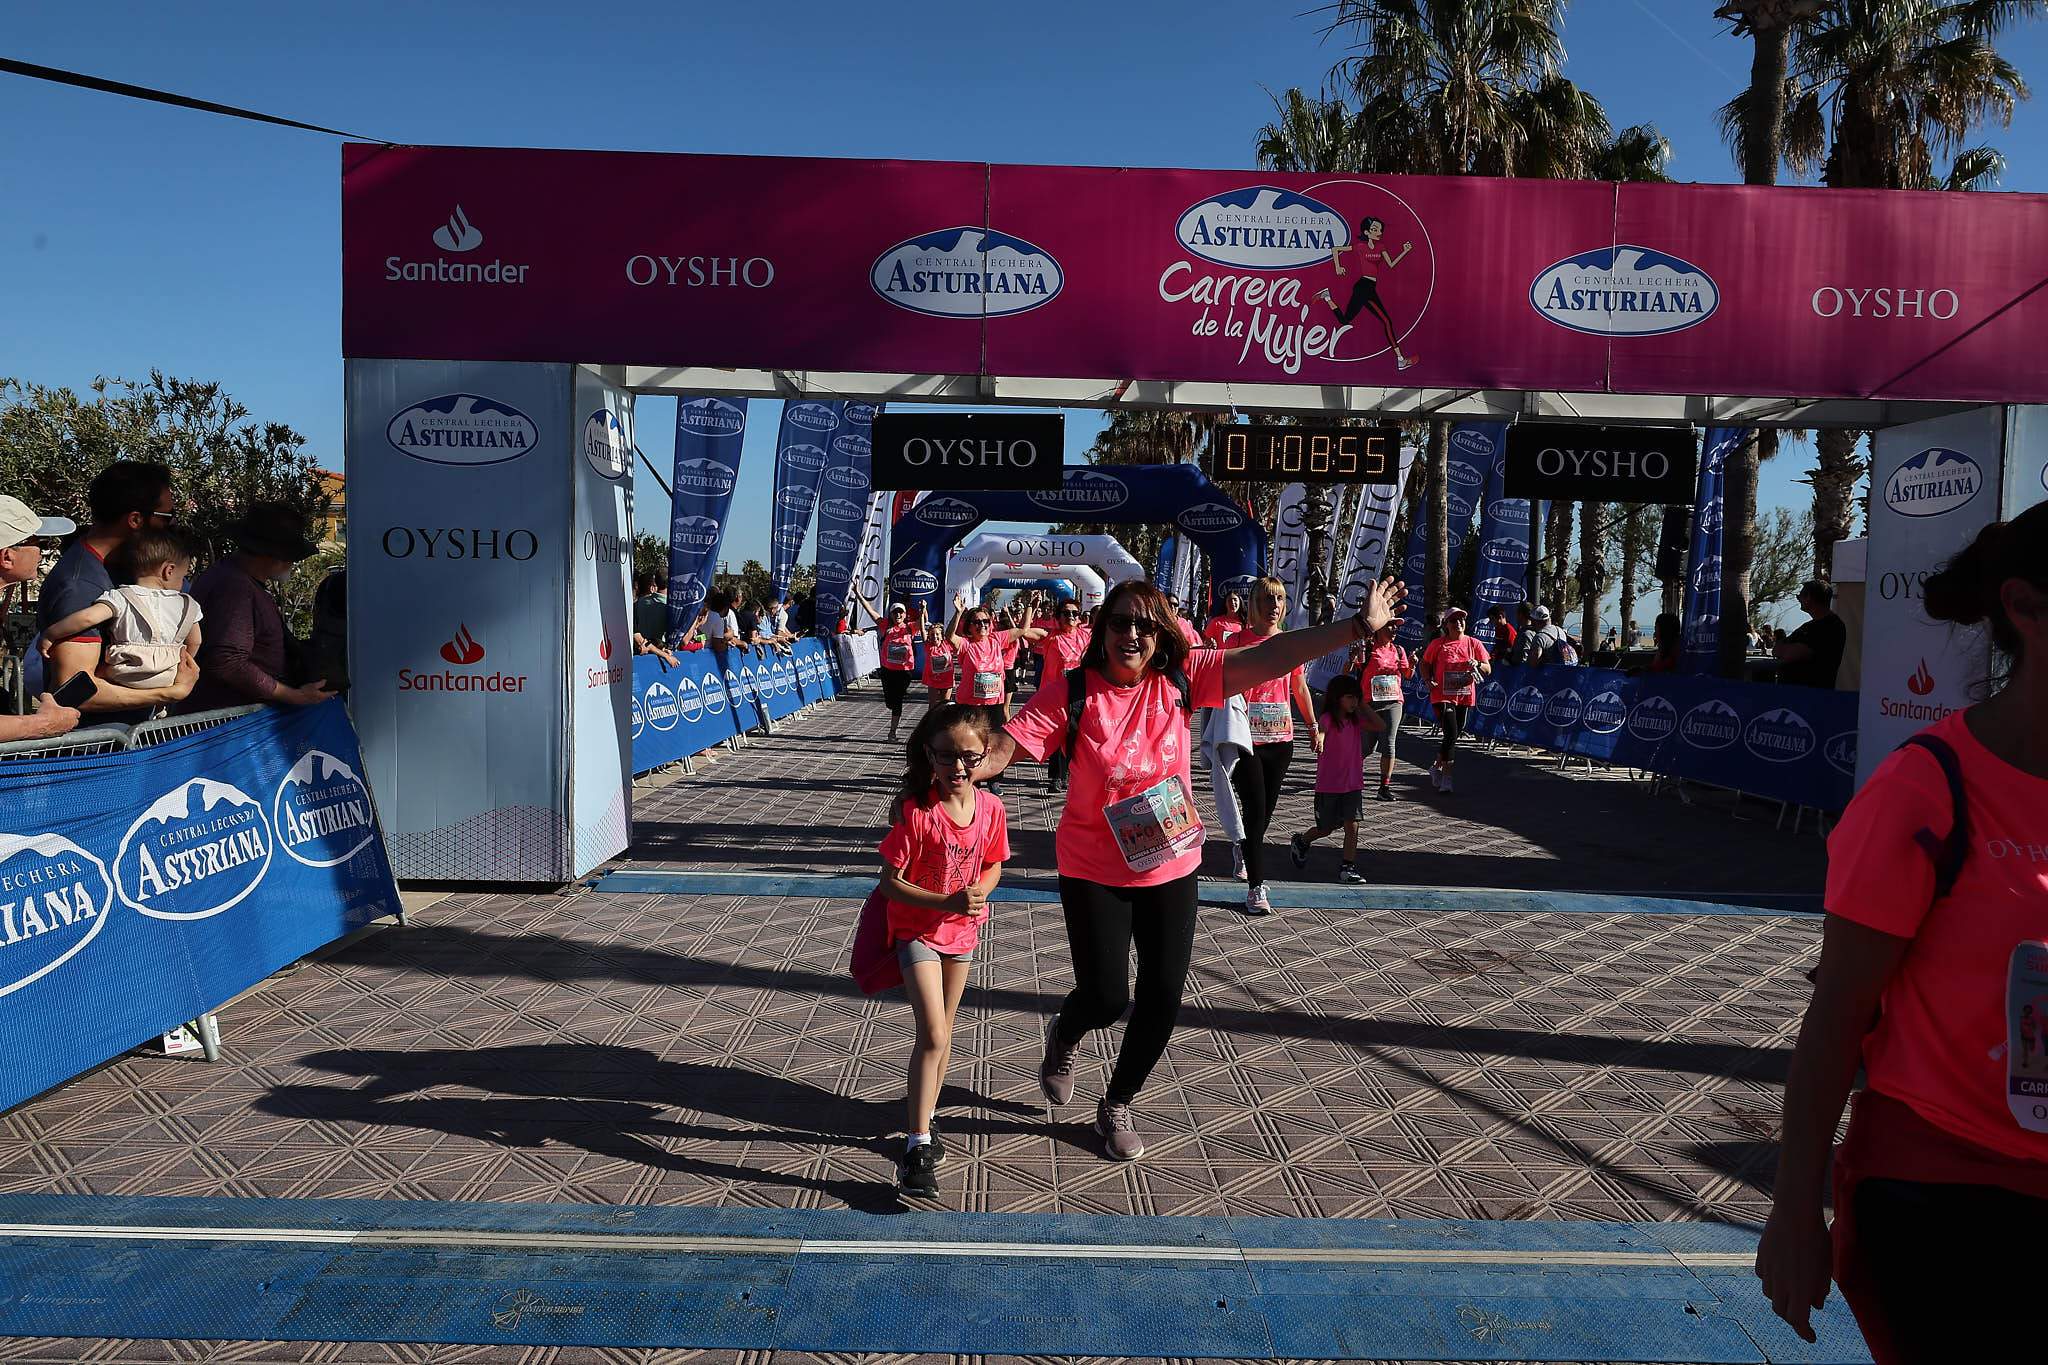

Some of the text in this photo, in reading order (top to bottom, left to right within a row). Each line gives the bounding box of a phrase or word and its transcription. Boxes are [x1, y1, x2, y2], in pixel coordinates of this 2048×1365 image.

[1189, 215, 1335, 250] ASTURIANA
[1216, 212, 1332, 225] CENTRAL LECHERA
[386, 256, 529, 284] Santander
[626, 254, 774, 288] OYSHO
[885, 259, 1048, 294] ASTURIANA
[915, 257, 1042, 268] CENTRAL ECHERA
[1159, 261, 1300, 308] Carrera
[1544, 277, 1703, 313] ASTURIANA
[1574, 276, 1699, 287] CENTRAL LECHERA
[1812, 287, 1959, 320] OYSHO
[1192, 304, 1353, 375] de la Mujer
[680, 409, 741, 429] ASTURIANA
[398, 420, 527, 448] ASTURIANA
[903, 438, 1036, 467] OYSHO
[1227, 434, 1385, 473] 01:08:55
[1536, 448, 1669, 479] OYSHO
[1034, 488, 1121, 501] ASTURIANA
[1890, 477, 1974, 503] ASTURIANA
[919, 509, 973, 520] ASTURIANA
[1183, 514, 1239, 525] ASTURIANA
[382, 527, 538, 560] OYSHO
[584, 531, 627, 564] OYSHO
[1006, 539, 1085, 557] OYSHO
[893, 579, 935, 589] ASTURIANA
[399, 669, 527, 692] Santander
[1880, 697, 1958, 721] Santande
[1683, 716, 1736, 739] ASTURIANA
[1750, 725, 1807, 753] ASTURIANA
[160, 823, 209, 847] CENTRAL
[287, 799, 369, 846] ASTURIAN
[137, 826, 267, 901] ASTURIANA
[0, 881, 98, 946] IANA
